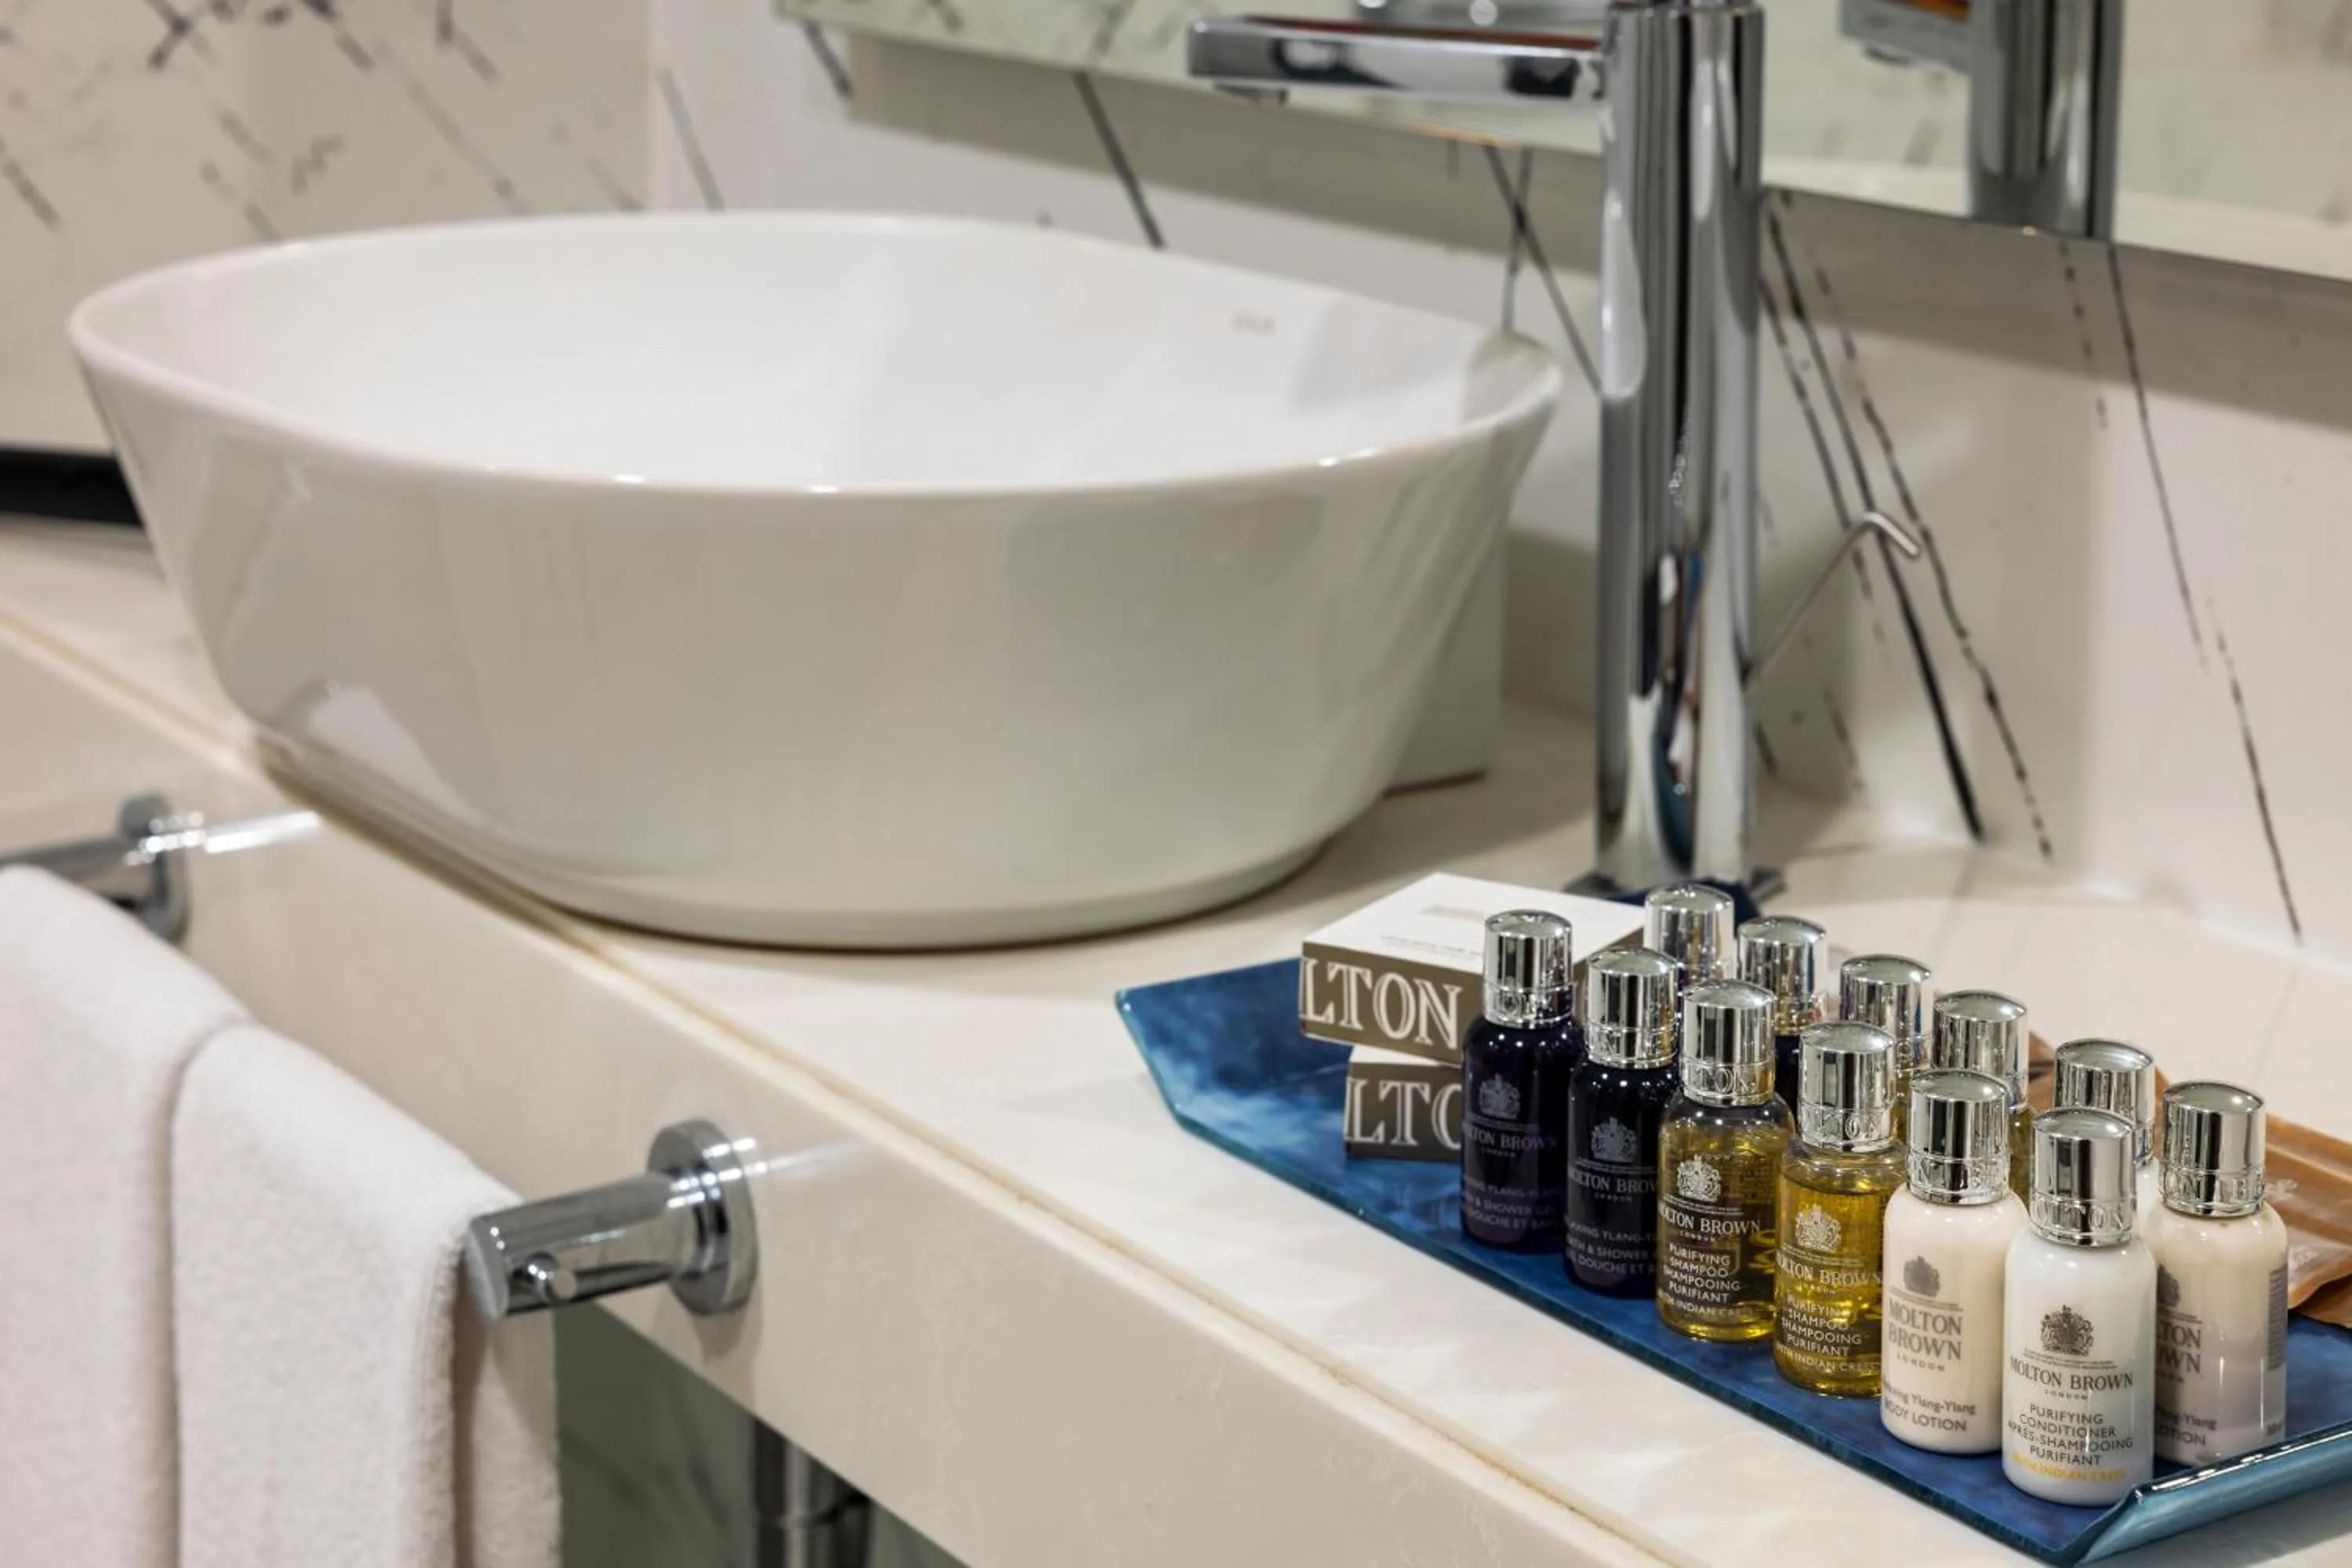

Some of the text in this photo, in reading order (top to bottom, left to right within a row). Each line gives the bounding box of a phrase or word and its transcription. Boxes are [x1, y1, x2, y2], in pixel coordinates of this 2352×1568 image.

[1300, 956, 1462, 1050] LTON
[1700, 1218, 1760, 1236] BROWN
[1669, 1243, 1731, 1267] PURIFYING
[1669, 1257, 1730, 1278] SHAMPOO
[1669, 1281, 1730, 1303] PURIFIANT
[1787, 1294, 1853, 1319] PURIFYING
[1889, 1297, 1963, 1336] MOLTON
[1781, 1317, 1862, 1345] SHAMPOOING
[1788, 1309, 1850, 1331] SHAMPOO
[1787, 1334, 1851, 1356] PURIFIANT
[1889, 1321, 1962, 1360] BROWN
[1795, 1352, 1836, 1372] INDIAN
[1896, 1353, 1945, 1372] LONDON
[2010, 1355, 2063, 1387] MOLTON
[2070, 1371, 2135, 1392] BROWN
[1911, 1392, 1977, 1415] Ylang-Ylang
[2030, 1404, 2104, 1425] PURIFYING
[1911, 1412, 1968, 1432] LOTION
[2020, 1414, 2117, 1439] CONDITIONER
[2030, 1445, 2103, 1466] PURIFIANT
